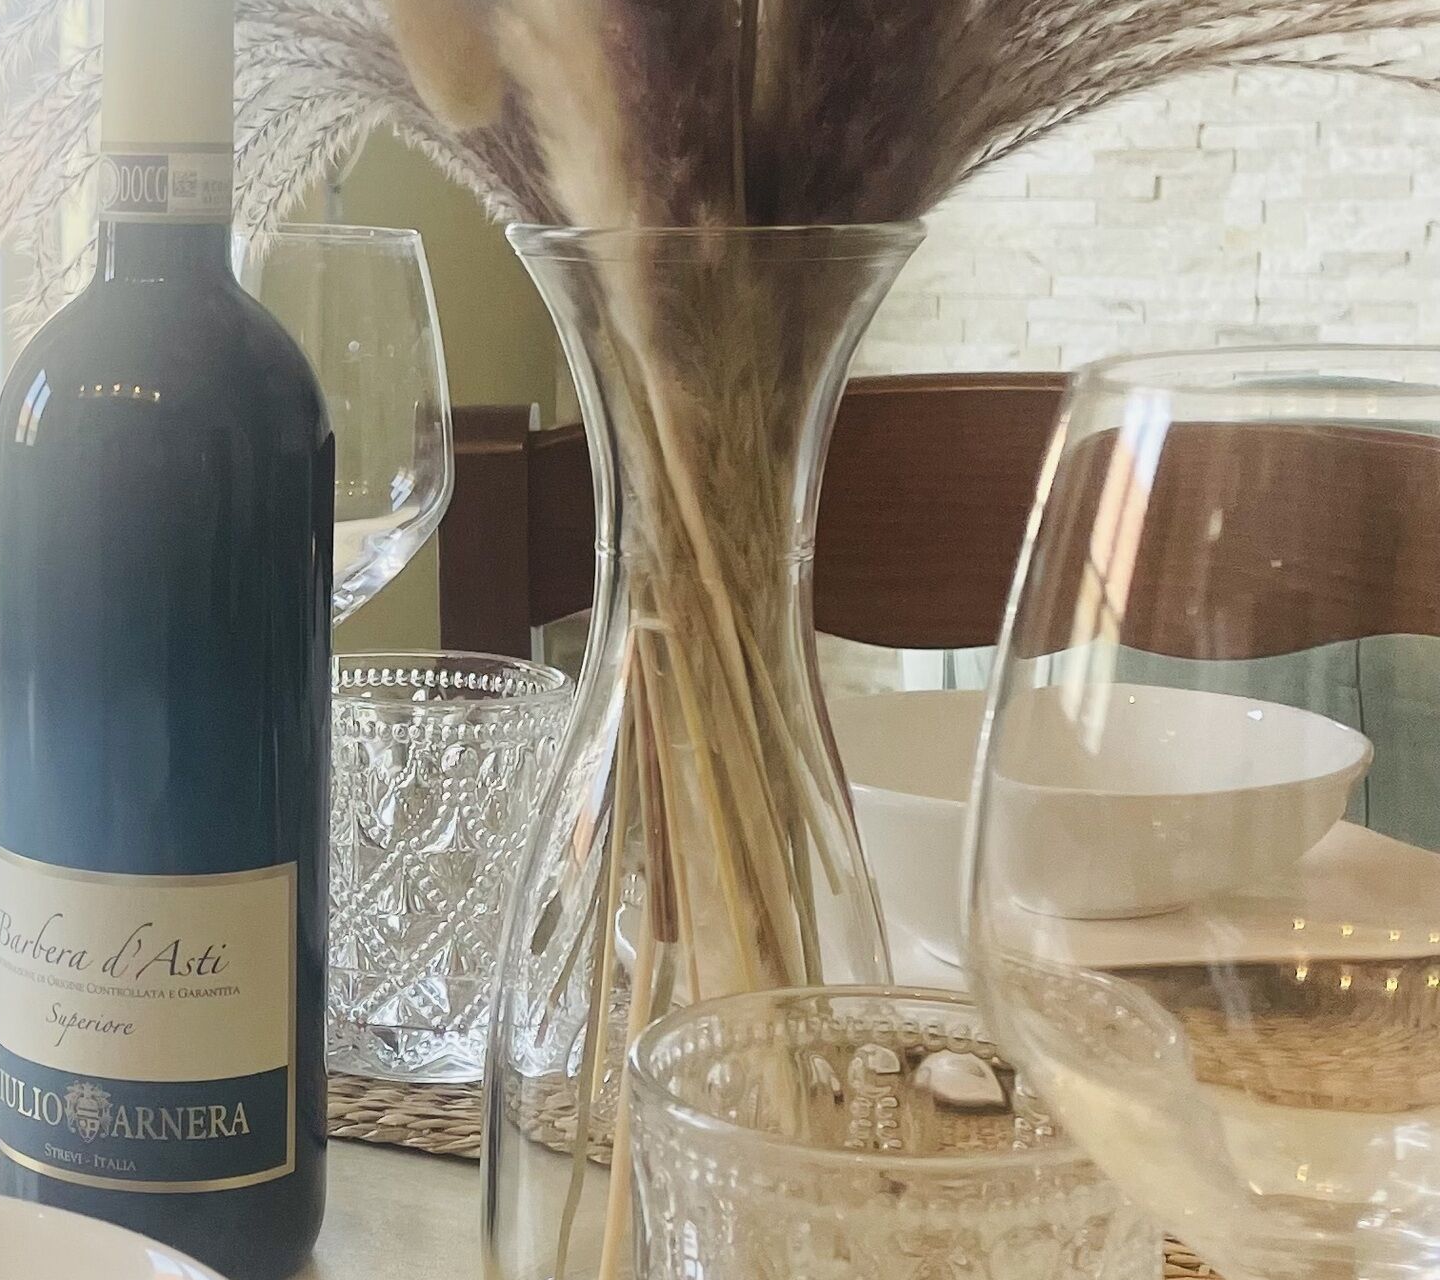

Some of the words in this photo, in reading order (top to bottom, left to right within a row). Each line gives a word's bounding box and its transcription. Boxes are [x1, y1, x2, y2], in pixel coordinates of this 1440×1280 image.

[121, 166, 167, 202] DOCG
[102, 922, 229, 980] d'Asti
[178, 985, 240, 999] GARANTITA
[46, 1002, 136, 1047] Superiore
[44, 1142, 82, 1165] STREVI
[94, 1154, 137, 1172] ITALIA
